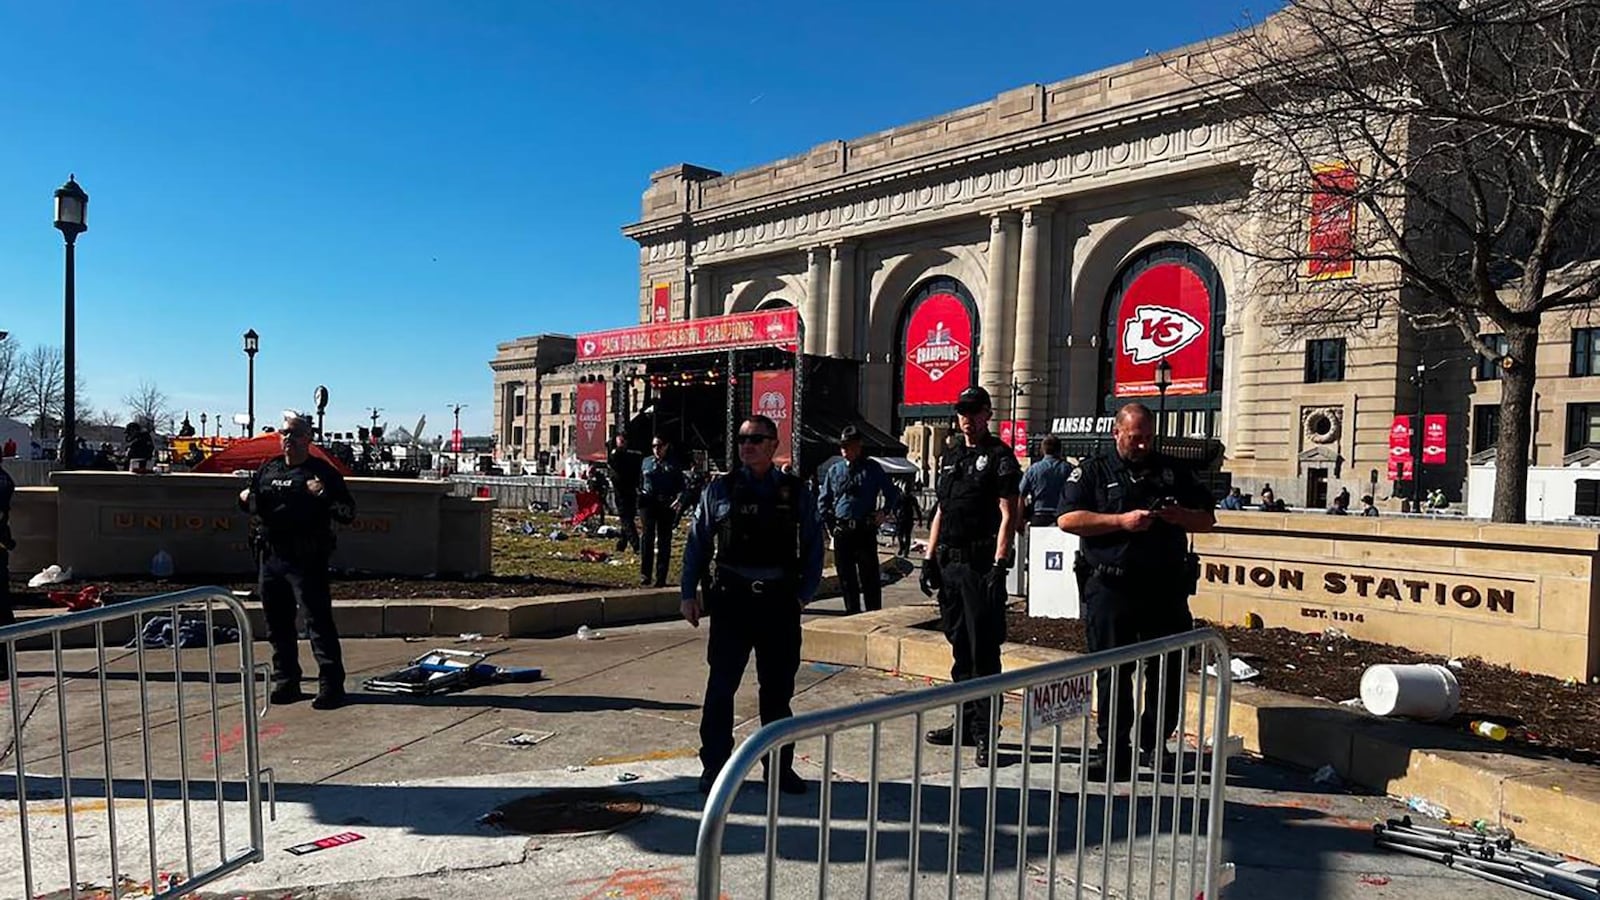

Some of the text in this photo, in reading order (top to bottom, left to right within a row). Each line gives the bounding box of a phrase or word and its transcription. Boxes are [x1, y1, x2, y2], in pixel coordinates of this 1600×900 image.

[1051, 416, 1116, 433] KANSAS CIT
[114, 512, 231, 530] UNION
[1205, 563, 1515, 613] NION STATION
[1301, 607, 1365, 623] EST. 1914
[1034, 676, 1091, 710] NATIONAL
